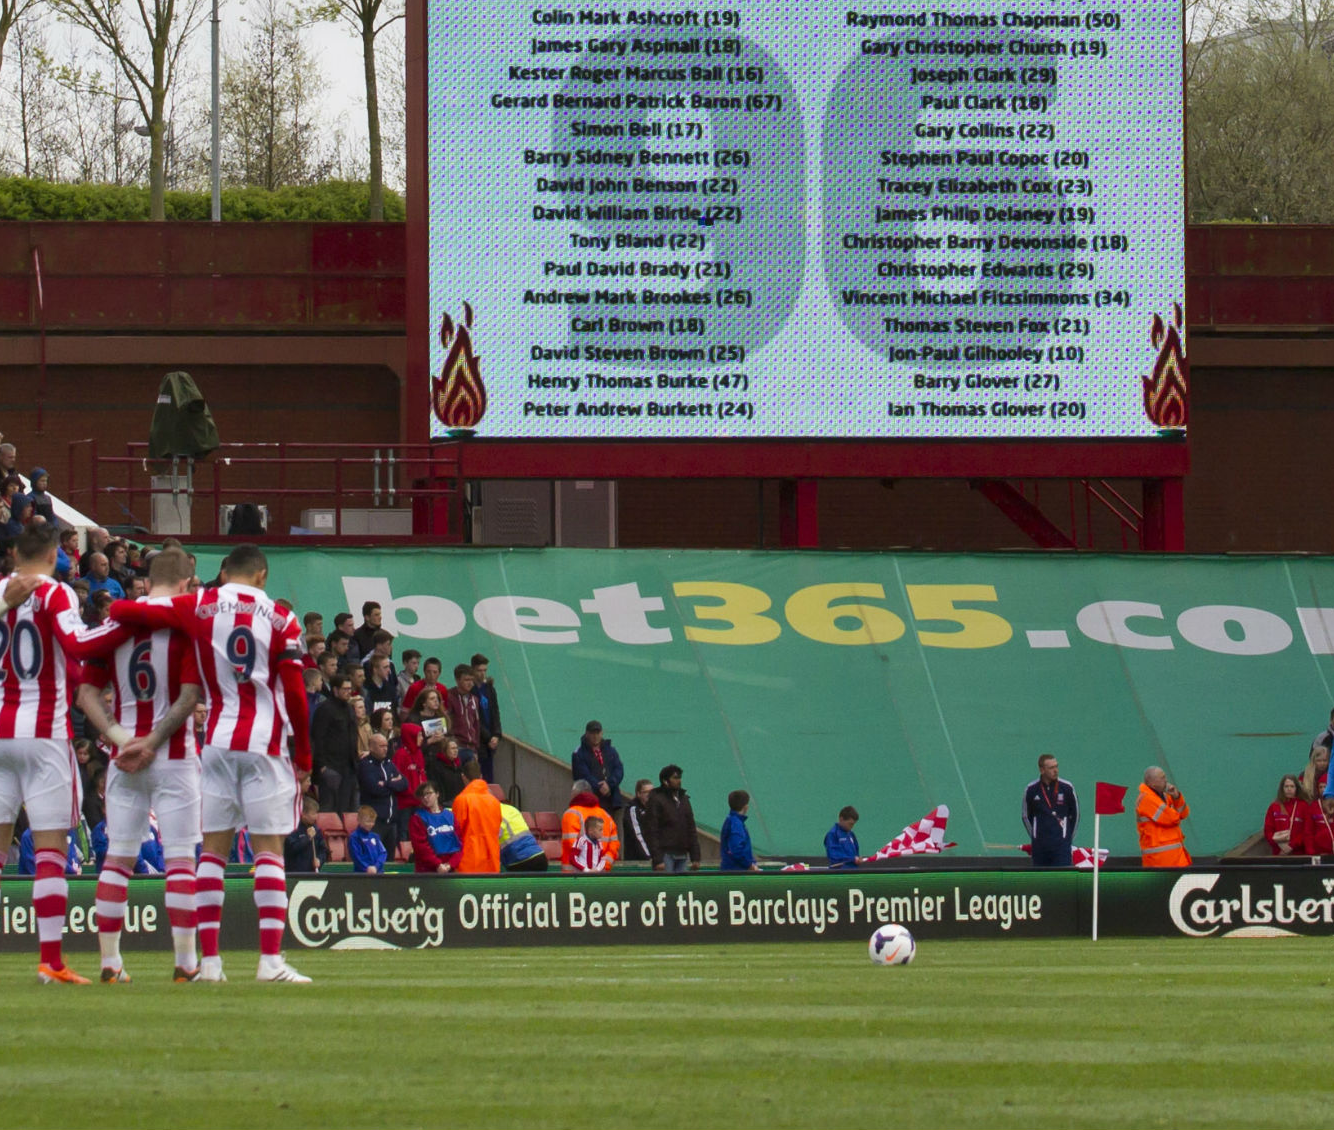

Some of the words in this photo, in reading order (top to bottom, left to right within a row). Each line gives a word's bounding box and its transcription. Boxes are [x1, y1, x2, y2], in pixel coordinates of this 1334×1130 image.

[533, 10, 574, 24] Colin
[580, 11, 620, 24] Mark
[627, 11, 698, 26] Ashcroft
[704, 11, 739, 28] (19)
[847, 11, 926, 29] Raymond
[933, 12, 997, 29] Thomas
[1003, 13, 1080, 29] Chapman
[1086, 13, 1120, 29] (50)
[532, 39, 582, 55] James
[588, 39, 628, 56] Gary
[632, 38, 700, 56] Aspinall
[704, 39, 741, 56] (18)
[862, 40, 900, 58] Gary
[905, 41, 1004, 58] Christopher
[1007, 41, 1066, 56] Church
[1072, 41, 1107, 57] (19)
[510, 66, 564, 80] Kester
[570, 65, 621, 84] Roger
[625, 66, 686, 81] Marcus
[691, 66, 723, 81] Ball
[728, 66, 764, 84] (16)
[911, 67, 969, 85] Joseph
[973, 67, 1016, 83] Clark
[1021, 67, 1057, 85] (29)
[492, 94, 547, 108] Gerard
[553, 94, 621, 109] Bernard
[626, 94, 685, 109] Patrick
[691, 94, 742, 109] Baron
[746, 94, 782, 112] (67)
[922, 95, 959, 109] Paul
[964, 95, 1006, 109] Clark
[1012, 96, 1047, 112] (18)
[570, 122, 624, 137] Simon
[629, 122, 661, 137] Bell
[668, 123, 702, 139] (17)
[914, 124, 954, 140] Gary
[959, 124, 1014, 138] Collins
[1020, 124, 1054, 140] (22)
[525, 150, 571, 167] Barry
[575, 149, 634, 167] Sidney
[640, 149, 708, 165] Bennett
[714, 150, 750, 168] (26)
[537, 178, 584, 192] David
[589, 177, 628, 195] John
[633, 178, 696, 192] Benson
[701, 178, 738, 196] (22)
[878, 178, 933, 196] Tracey
[938, 179, 1017, 194] Elizabeth
[1021, 179, 1052, 194] Cox
[1057, 179, 1093, 196] (23)
[876, 207, 926, 223] James
[931, 206, 980, 223] Philip
[985, 206, 1054, 224] Delaney
[1059, 207, 1094, 224] (19)
[571, 234, 610, 251] Tony
[615, 233, 664, 248] Bland
[669, 234, 705, 250] (22)
[842, 234, 941, 252] Christopher
[948, 235, 993, 252] Barry
[998, 234, 1087, 250] Devonside
[1093, 235, 1128, 251] (18)
[545, 262, 581, 276] Paul
[588, 262, 634, 276] David
[641, 262, 690, 279] Brady
[696, 262, 731, 279] (21)
[878, 262, 976, 279] Christopher
[982, 262, 1053, 277] Edwards
[1058, 262, 1094, 280] (29)
[524, 290, 590, 304] Andrew
[595, 290, 636, 305] Mark
[642, 290, 711, 305] Brookes
[716, 290, 752, 307] (26)
[571, 318, 604, 332] Carl
[608, 318, 663, 332] Brown
[669, 318, 705, 335] (18)
[883, 318, 950, 333] Thomas
[955, 318, 1014, 333] Steven
[1019, 318, 1048, 332] Fox
[1053, 319, 1089, 335] (21)
[532, 346, 579, 360] David
[585, 345, 644, 360] Steven
[649, 346, 705, 360] Brown
[709, 345, 745, 363] (25)
[890, 345, 959, 362] Jon-Paul
[964, 345, 1043, 363] Gilhooley
[1049, 346, 1083, 363] (10)
[529, 375, 579, 391] Henry
[587, 374, 651, 388] Thomas
[658, 374, 708, 388] Burke
[712, 374, 748, 390] (47)
[914, 375, 959, 392] Barry
[966, 375, 1018, 388] Glover
[1025, 375, 1059, 391] (27)
[524, 403, 569, 416] Peter
[577, 402, 641, 416] Andrew
[648, 402, 712, 416] Burkett
[718, 402, 753, 419] (24)
[889, 403, 914, 416] Ian
[921, 402, 985, 416] Thomas
[991, 403, 1044, 416] Glover
[1051, 403, 1085, 419] (20)
[226, 625, 256, 684] 9
[129, 640, 157, 702] 6
[289, 880, 445, 949] Carlsberg
[458, 893, 560, 929] Official
[569, 892, 630, 927] Beer
[640, 891, 667, 926] of
[677, 891, 718, 926] the
[729, 890, 838, 934] Barclays
[849, 887, 945, 923] Premier
[955, 886, 1042, 930] League
